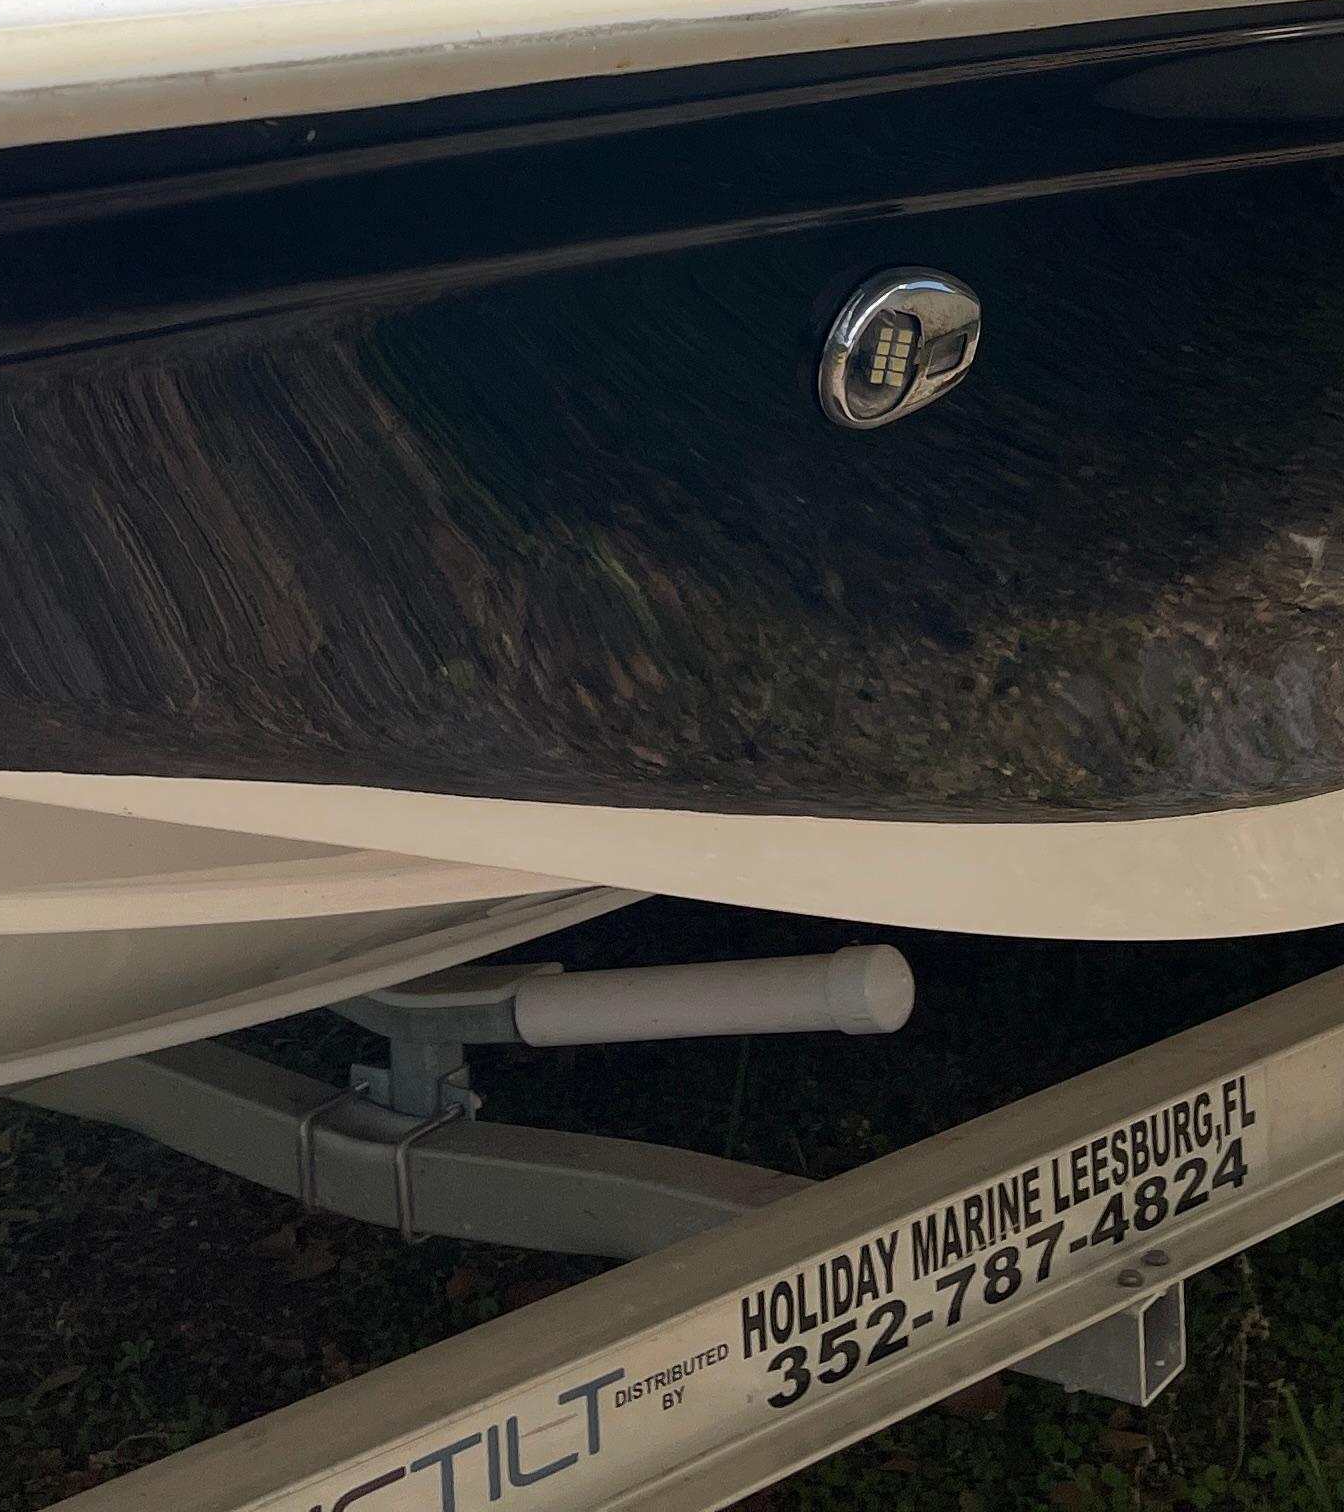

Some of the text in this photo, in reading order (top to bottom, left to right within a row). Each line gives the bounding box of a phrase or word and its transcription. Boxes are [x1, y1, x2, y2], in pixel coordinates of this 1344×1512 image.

[741, 1229, 900, 1360] HOLIDAY
[912, 1164, 1043, 1281] MARINE
[766, 1137, 1249, 1409] 352-787-4824
[614, 1342, 729, 1409] DISTRIBUTED
[661, 1387, 686, 1410] BY
